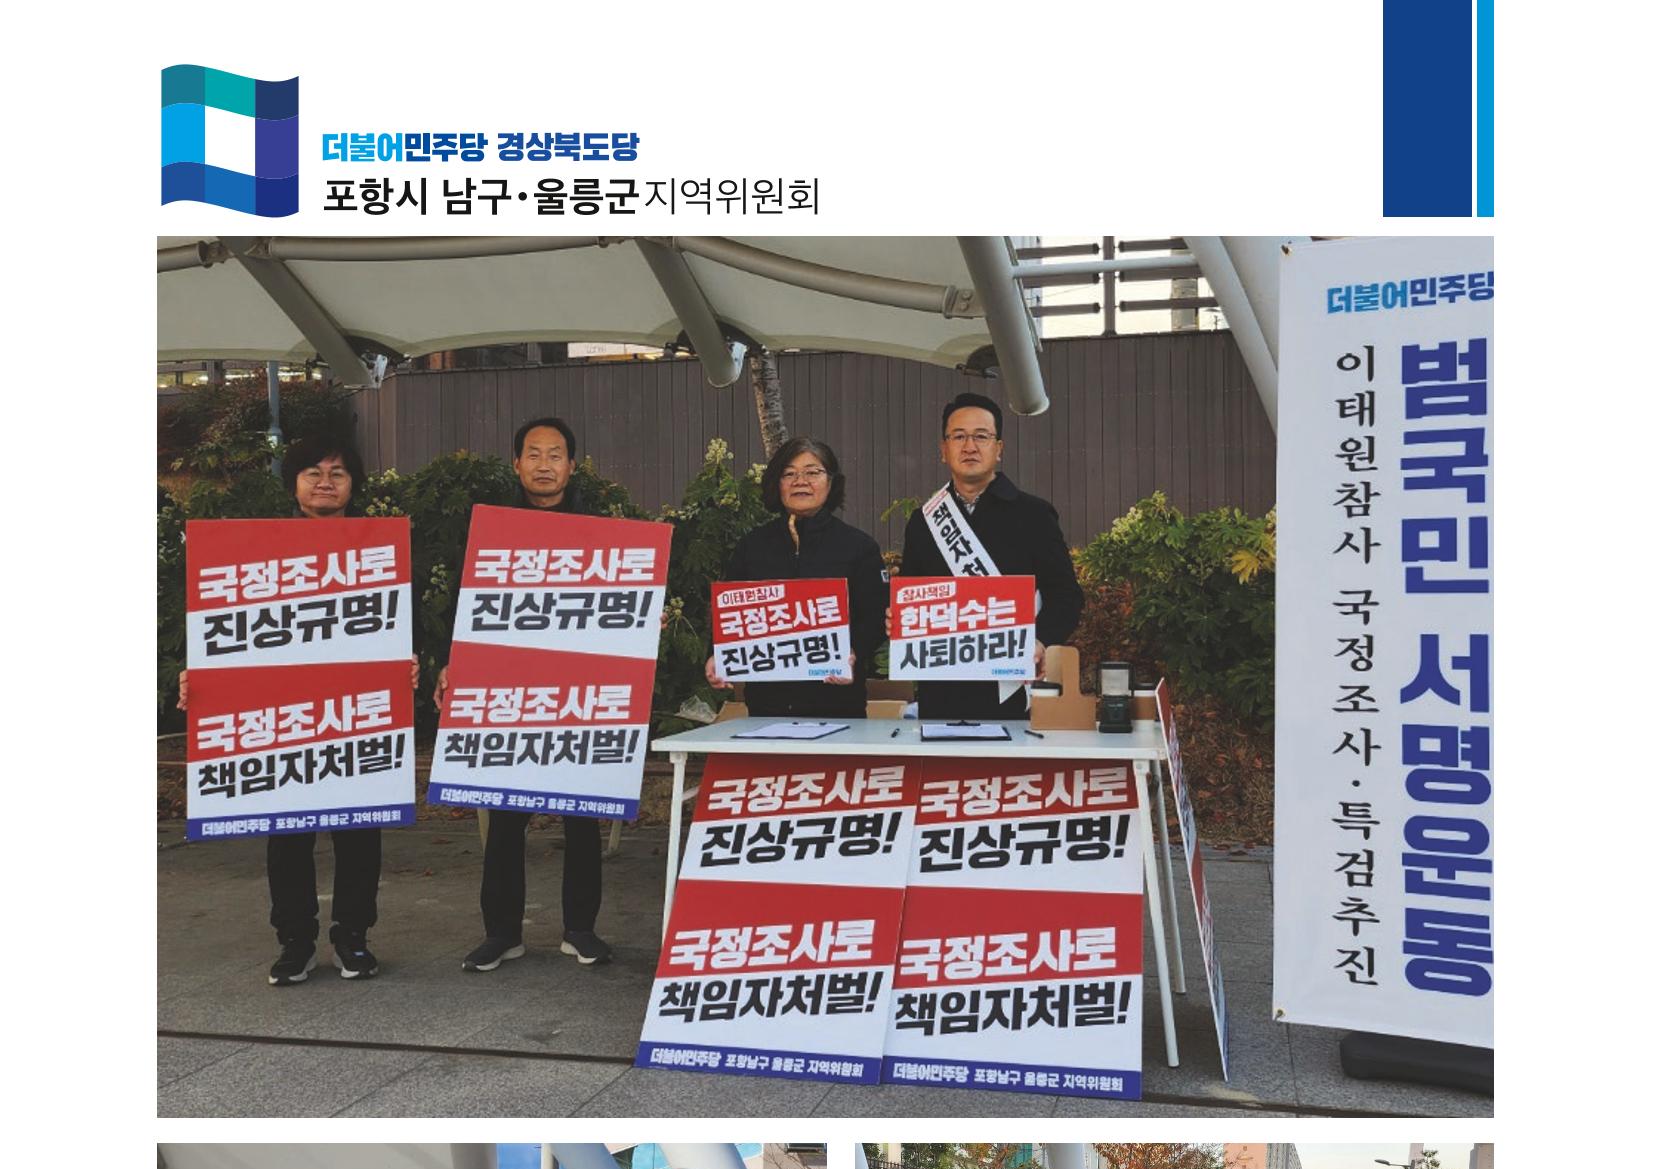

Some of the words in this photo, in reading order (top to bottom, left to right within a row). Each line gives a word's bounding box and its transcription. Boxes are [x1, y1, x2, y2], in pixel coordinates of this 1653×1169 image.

[1327, 271, 1494, 315] 더불어민주당
[1333, 345, 1381, 564] 이태원참사
[1400, 337, 1490, 594] 범국민
[198, 544, 397, 603] 국정조사로
[474, 547, 657, 584] 국정조사로
[203, 589, 400, 657] 진상규명!
[471, 590, 655, 632] 진상규명!
[719, 596, 842, 638] 국정조사로
[900, 596, 1017, 637] 한덕수는
[722, 632, 842, 676] 진상규명!
[899, 628, 1027, 670] 사퇴하라!
[196, 689, 392, 753] 국정조사로
[449, 684, 633, 724] 국정조사로
[198, 732, 407, 798] 책임자처벌!
[444, 730, 640, 768] 책임자처벌!
[706, 766, 905, 815] 국정조사로
[920, 766, 1130, 819] 국정조사로
[1400, 634, 1494, 997] 서명운동
[700, 811, 902, 868] 진상규명!
[919, 814, 1131, 873] 진상규명!
[668, 919, 875, 971] 국정조사로
[900, 926, 1117, 982] 국정조사로
[658, 971, 884, 1024] 책임자처벌!
[895, 980, 1132, 1036] 책임자처벌!
